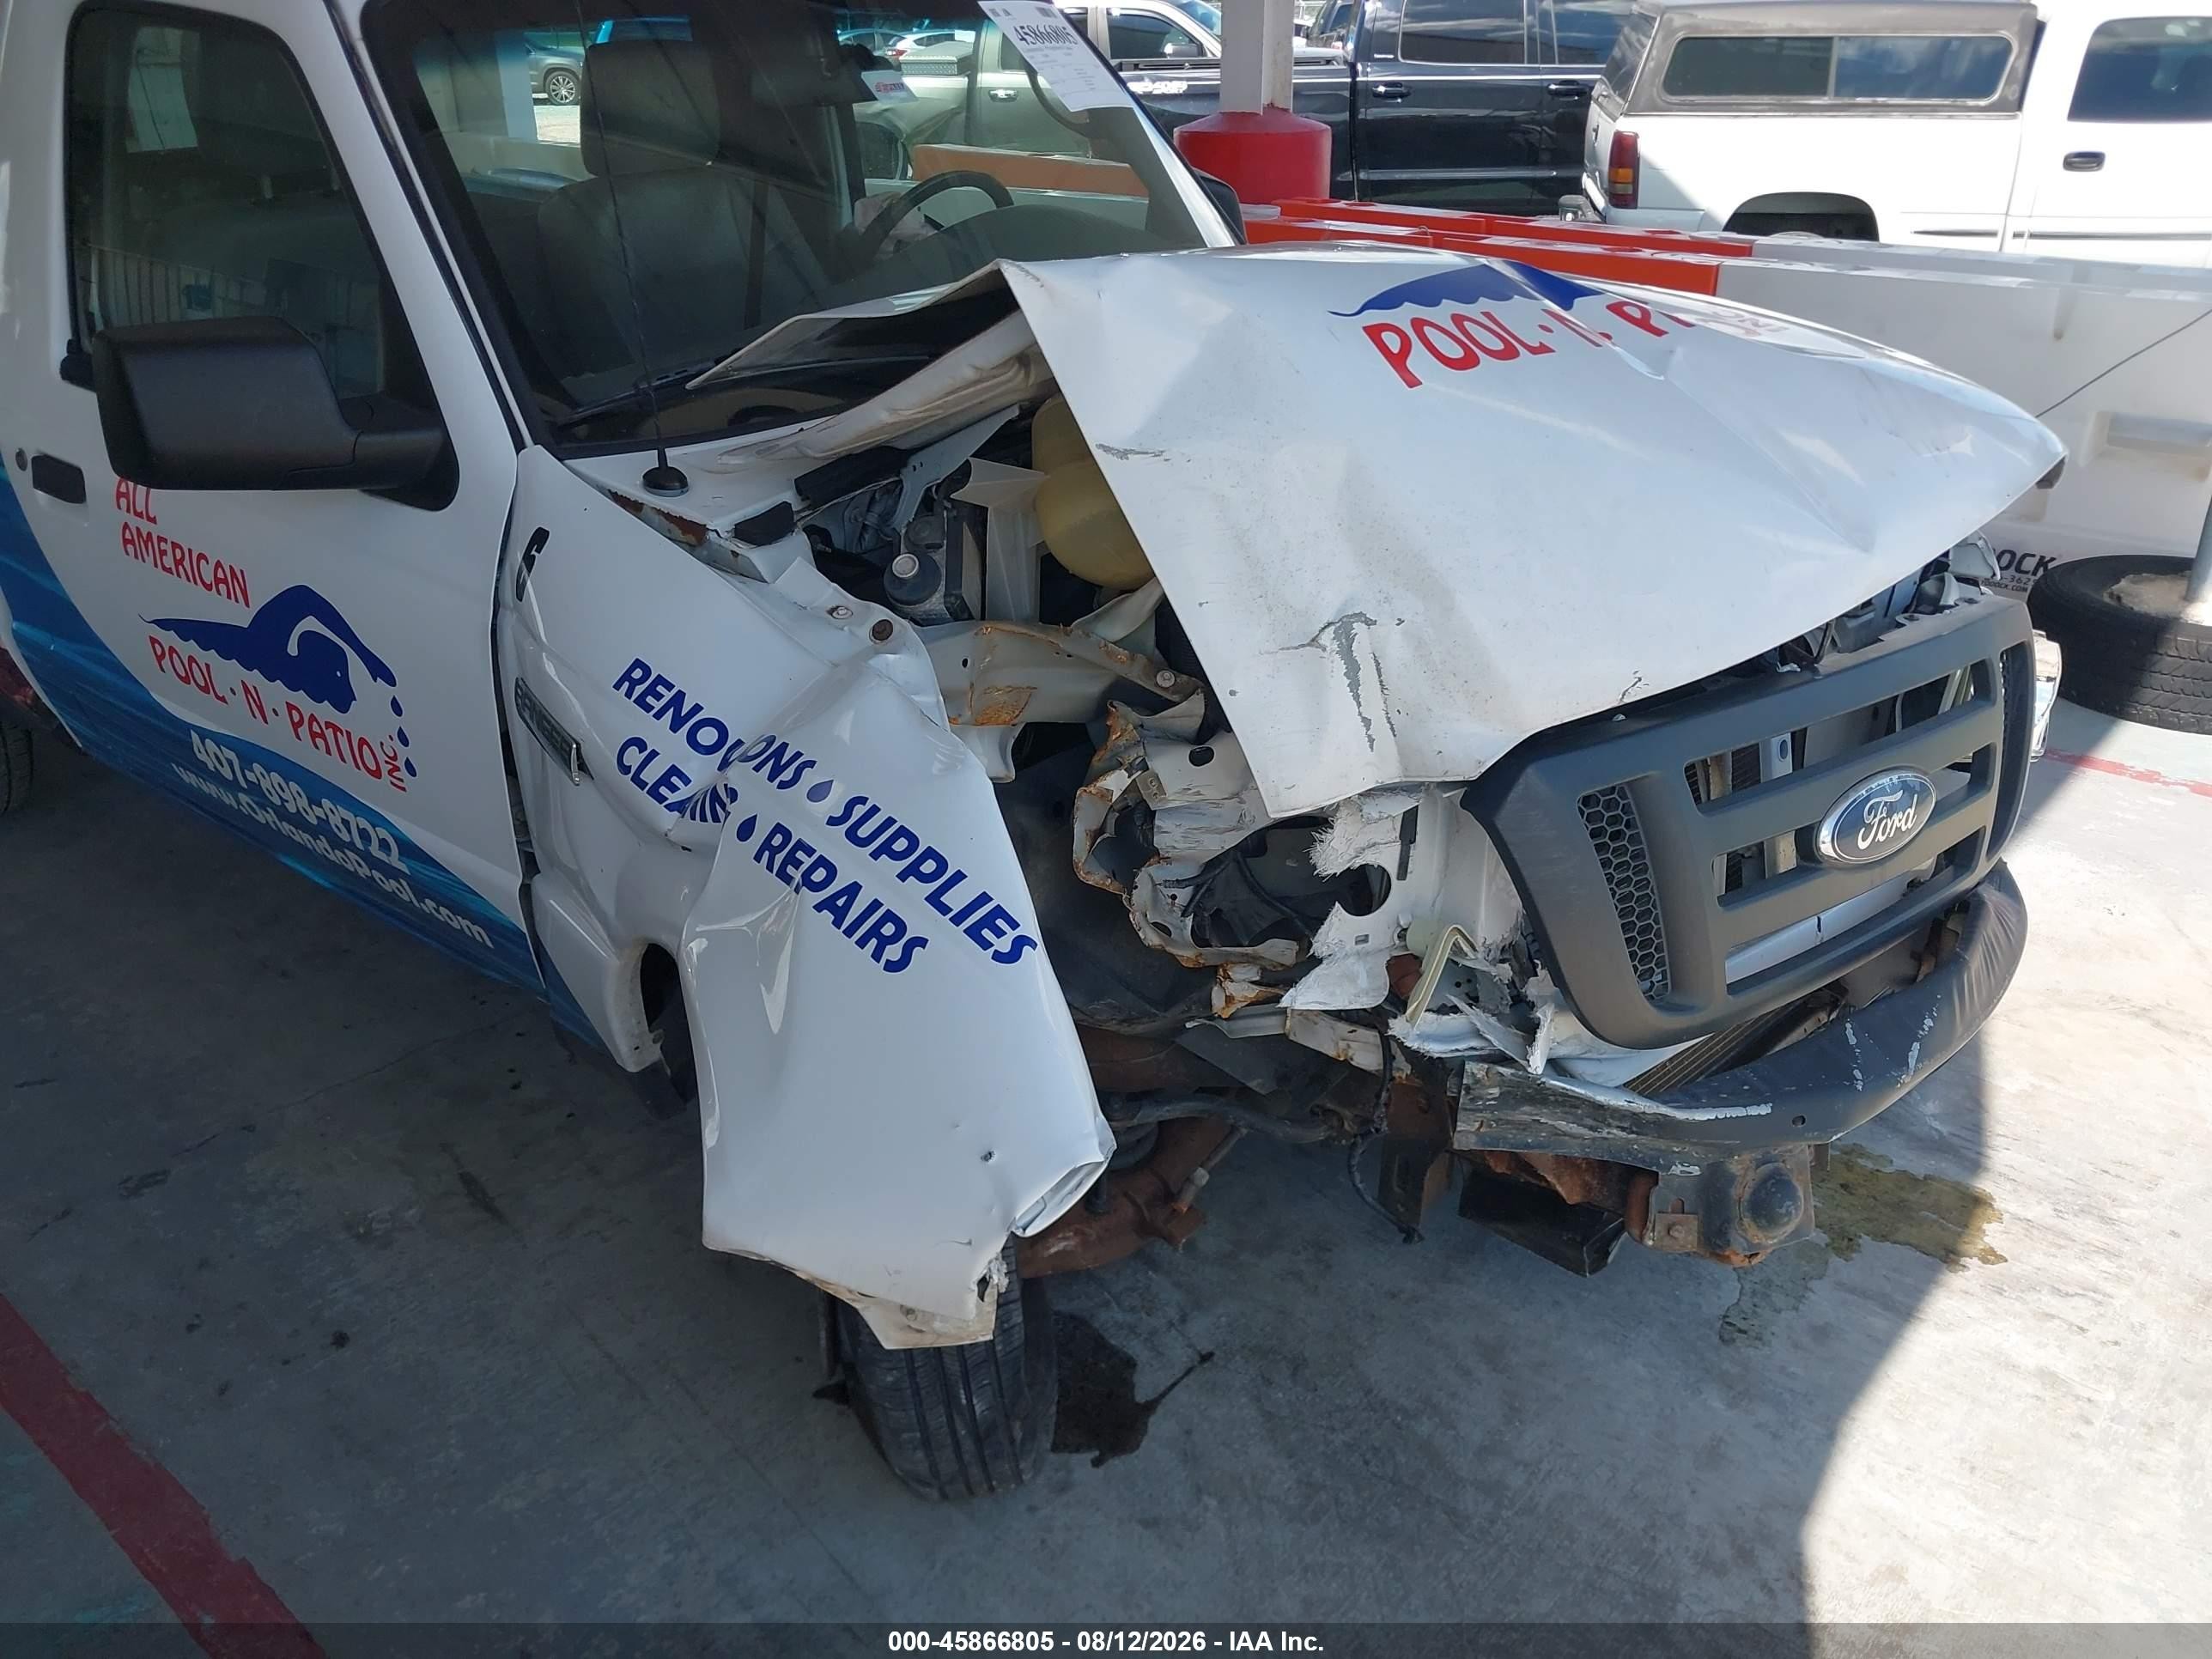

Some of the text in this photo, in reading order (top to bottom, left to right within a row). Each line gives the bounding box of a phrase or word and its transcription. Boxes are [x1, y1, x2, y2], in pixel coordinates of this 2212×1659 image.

[1013, 24, 1078, 46] 45866805
[115, 477, 157, 525] ALL
[122, 521, 250, 608] AMERICAN
[1992, 547, 2057, 576] OCK
[190, 729, 411, 876] 407-898-8722
[1857, 789, 1917, 850] Ford
[753, 822, 929, 974] REPAIRS
[826, 795, 1038, 965] SUPPLIES
